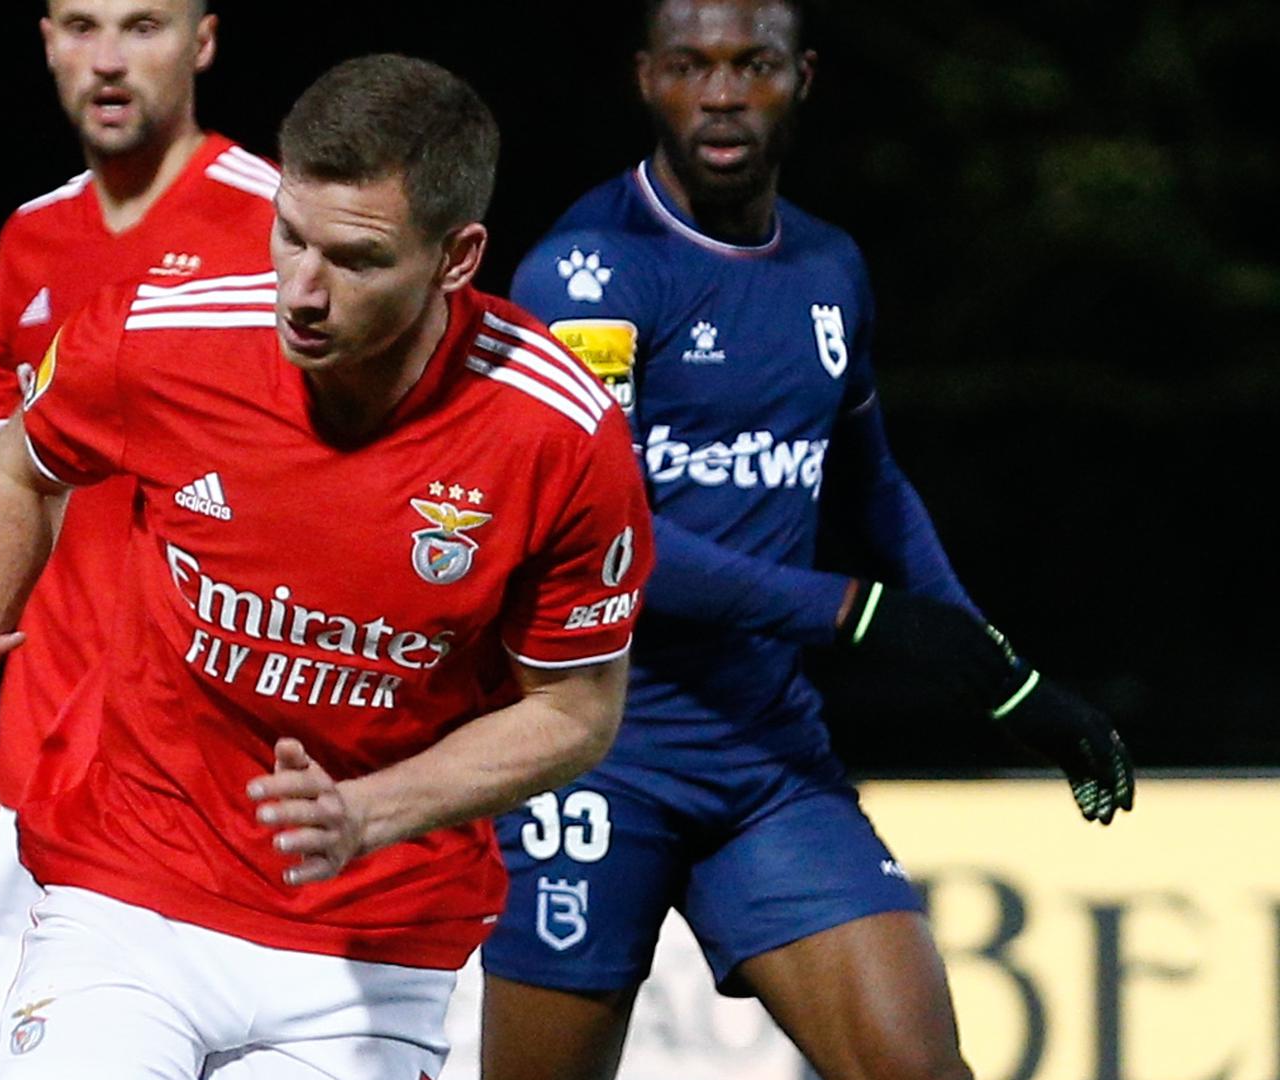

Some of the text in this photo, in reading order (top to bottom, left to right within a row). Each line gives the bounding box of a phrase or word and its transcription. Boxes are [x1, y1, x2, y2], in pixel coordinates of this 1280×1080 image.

[175, 491, 233, 521] adidas
[166, 540, 456, 669] Emirates
[185, 628, 403, 709] FLY BETTER
[521, 790, 612, 863] 33
